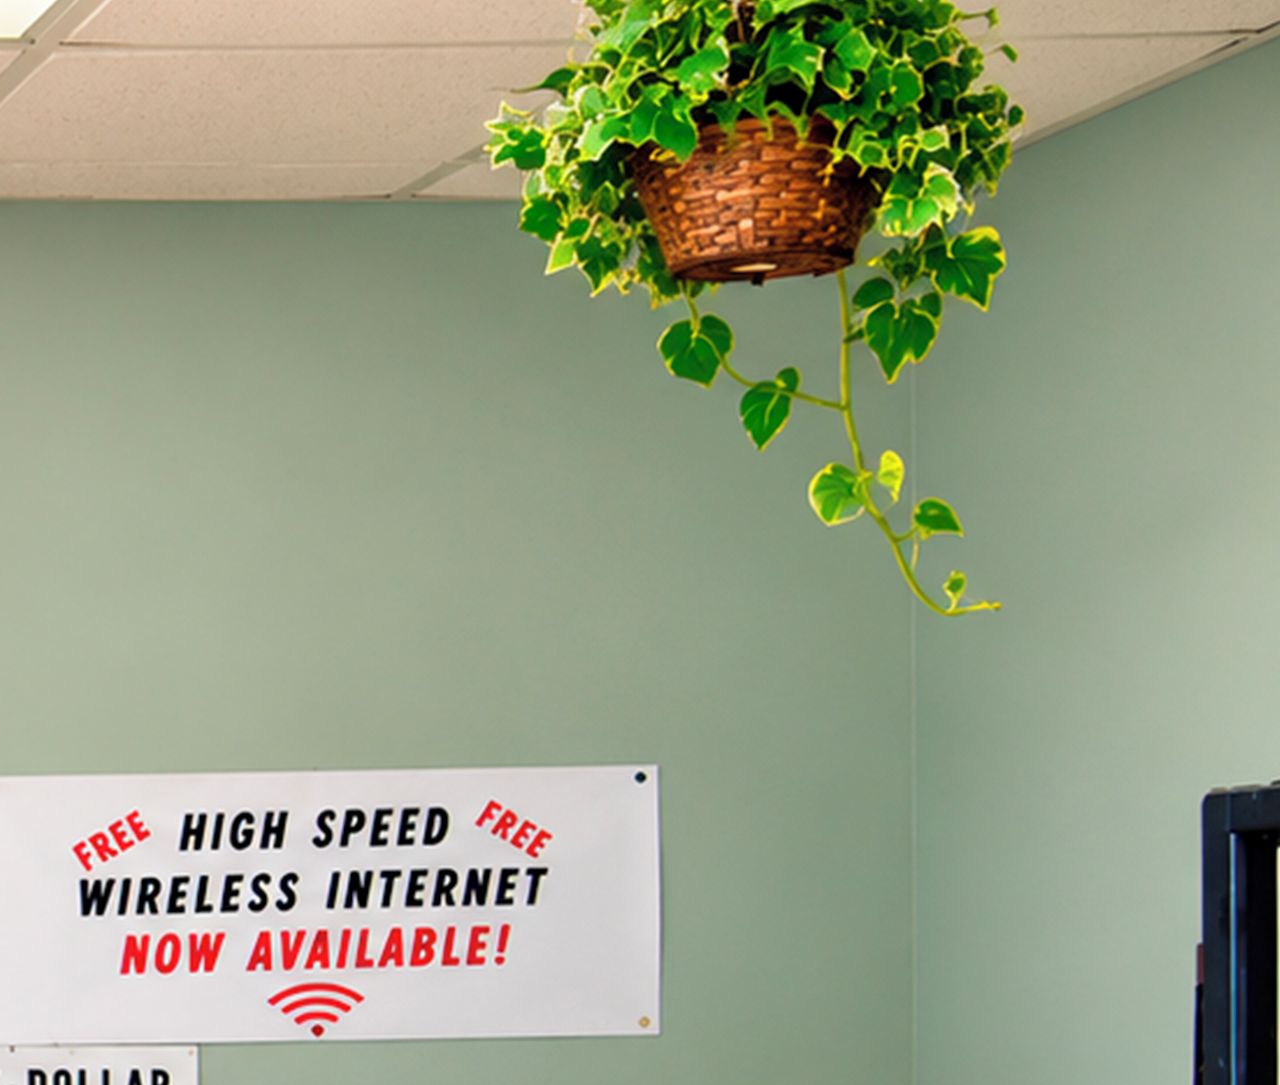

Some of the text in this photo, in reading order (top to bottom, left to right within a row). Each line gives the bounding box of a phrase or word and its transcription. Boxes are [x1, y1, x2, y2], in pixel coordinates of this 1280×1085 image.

[73, 810, 150, 871] FREE
[180, 808, 448, 850] HIGH SPEED
[476, 801, 552, 857] FREE
[81, 868, 548, 916] WIRELESS INTERNET
[121, 924, 510, 975] NOW AVAILABLE!
